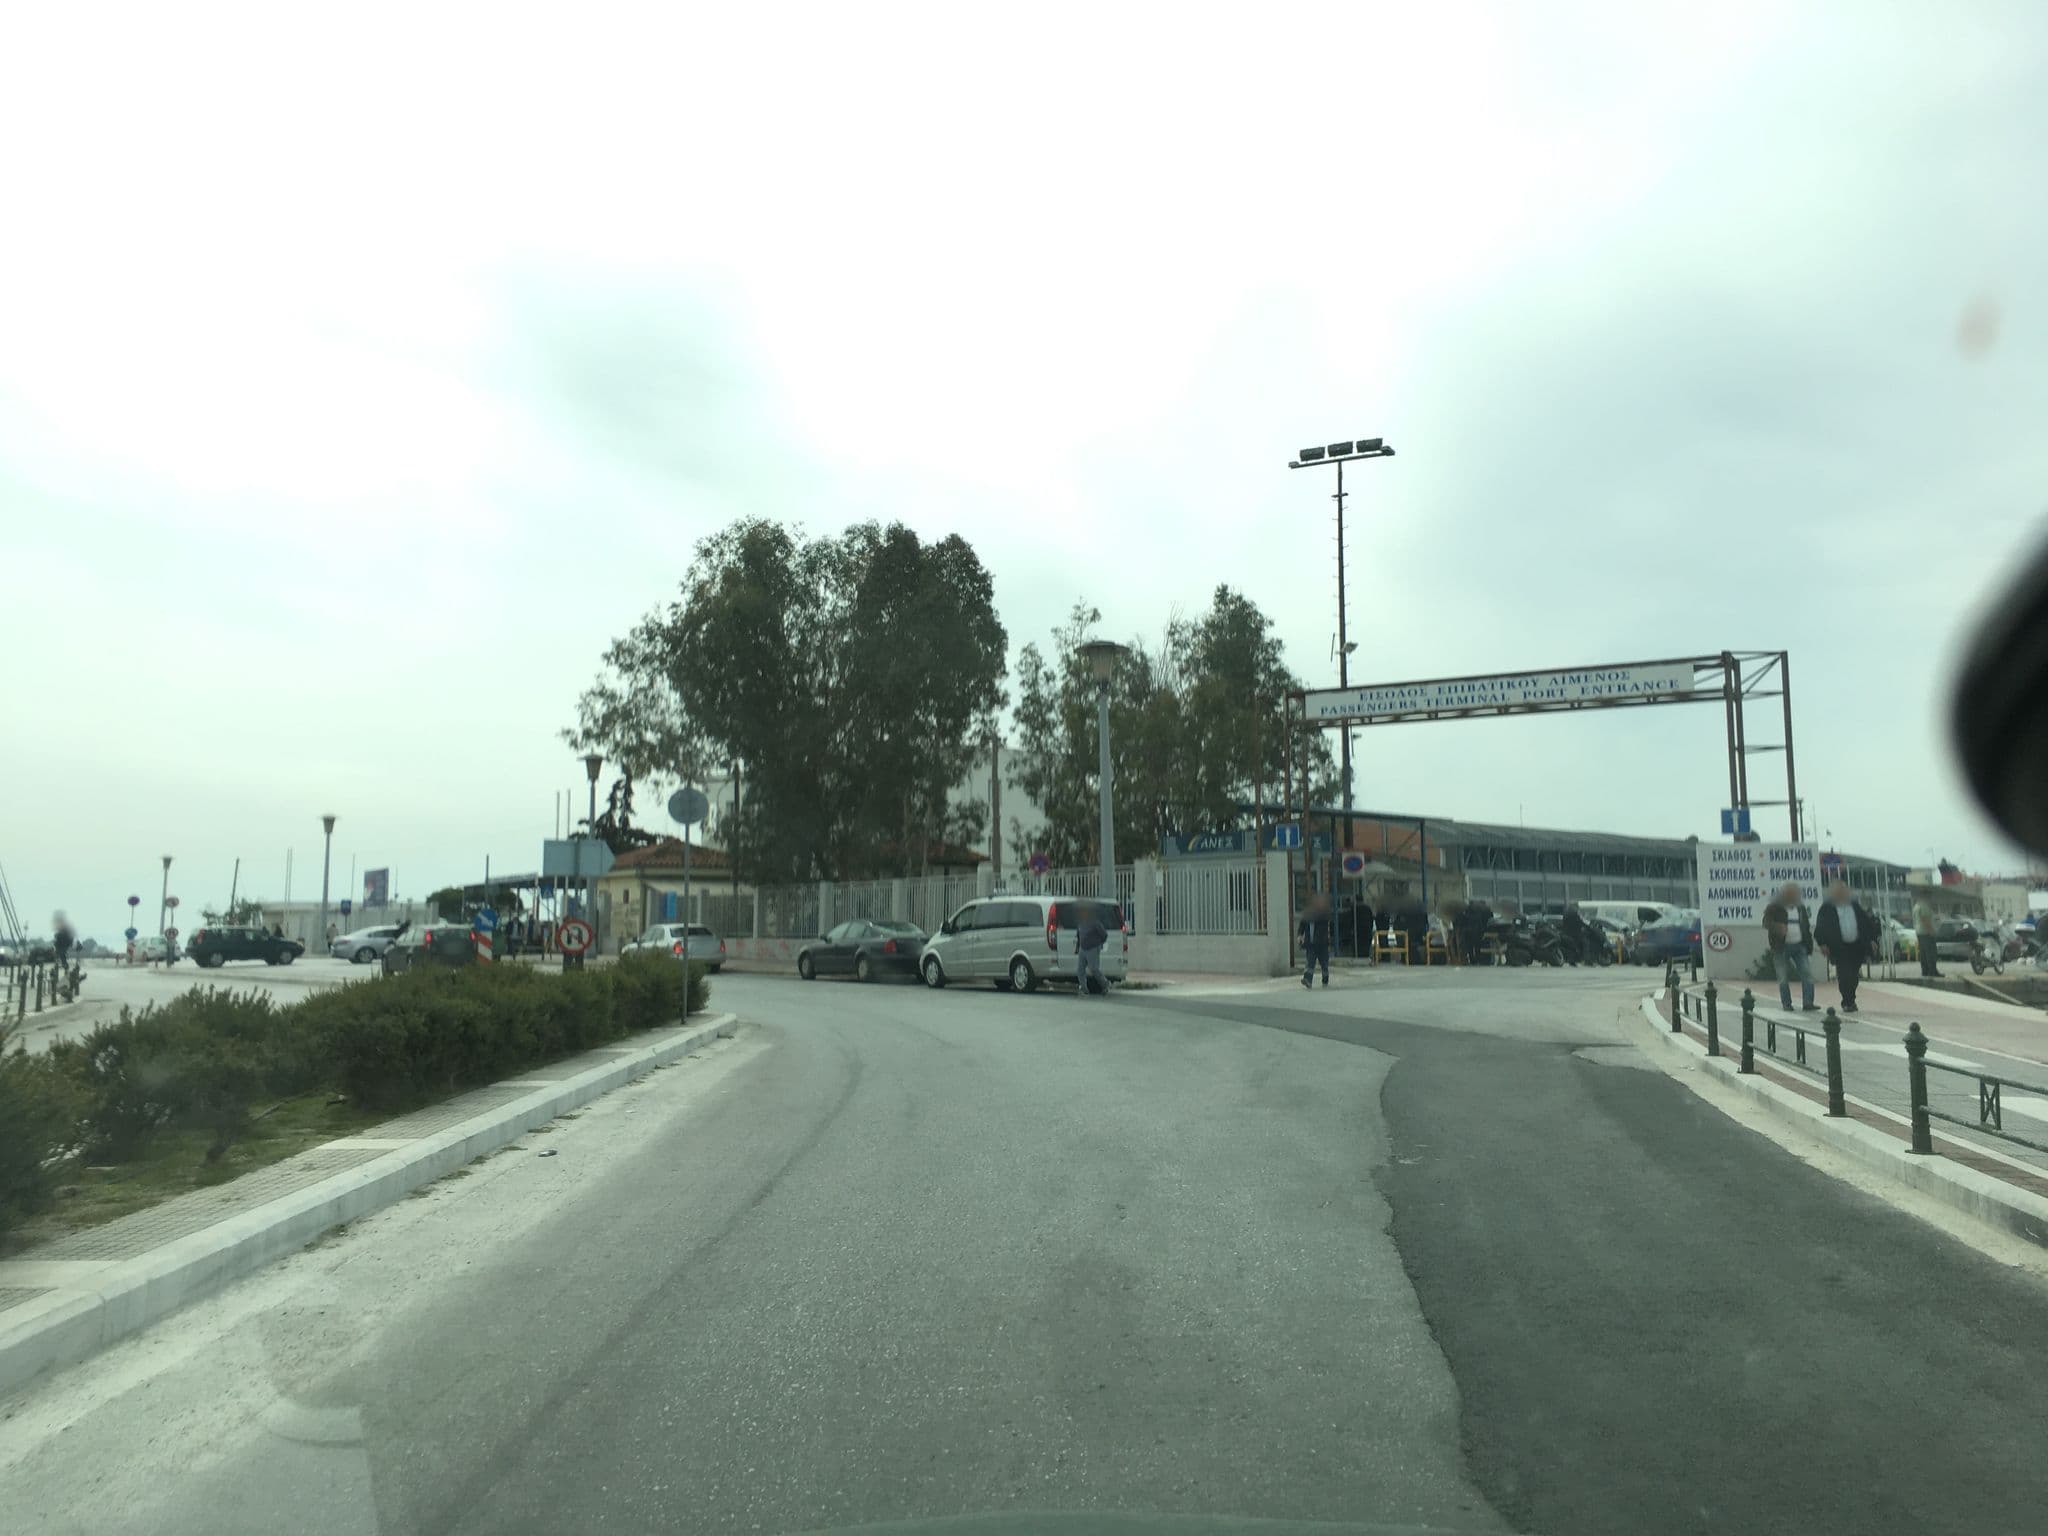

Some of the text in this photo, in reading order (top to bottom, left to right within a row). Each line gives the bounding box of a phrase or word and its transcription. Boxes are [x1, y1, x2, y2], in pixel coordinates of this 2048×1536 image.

[1360, 671, 1631, 702] ΕΙΣΟΔΟΣ ΕΠΙΒΑΤΙΚΟΥ ΛΙΜΕΝΟΣ
[1321, 679, 1680, 716] PASSENGERS TERMINAL PORT ENTRANCE
[1712, 848, 1752, 862] ΣΚΙΑΘΟΣ
[1769, 848, 1813, 862] SKIATHOS
[1709, 868, 1756, 881] ΣΚΟΠΕΛΟΣ
[1769, 867, 1815, 881] SKOPELOS
[1718, 906, 1753, 919] ΣΚΥΡΟΣ
[1712, 935, 1727, 947] 20
